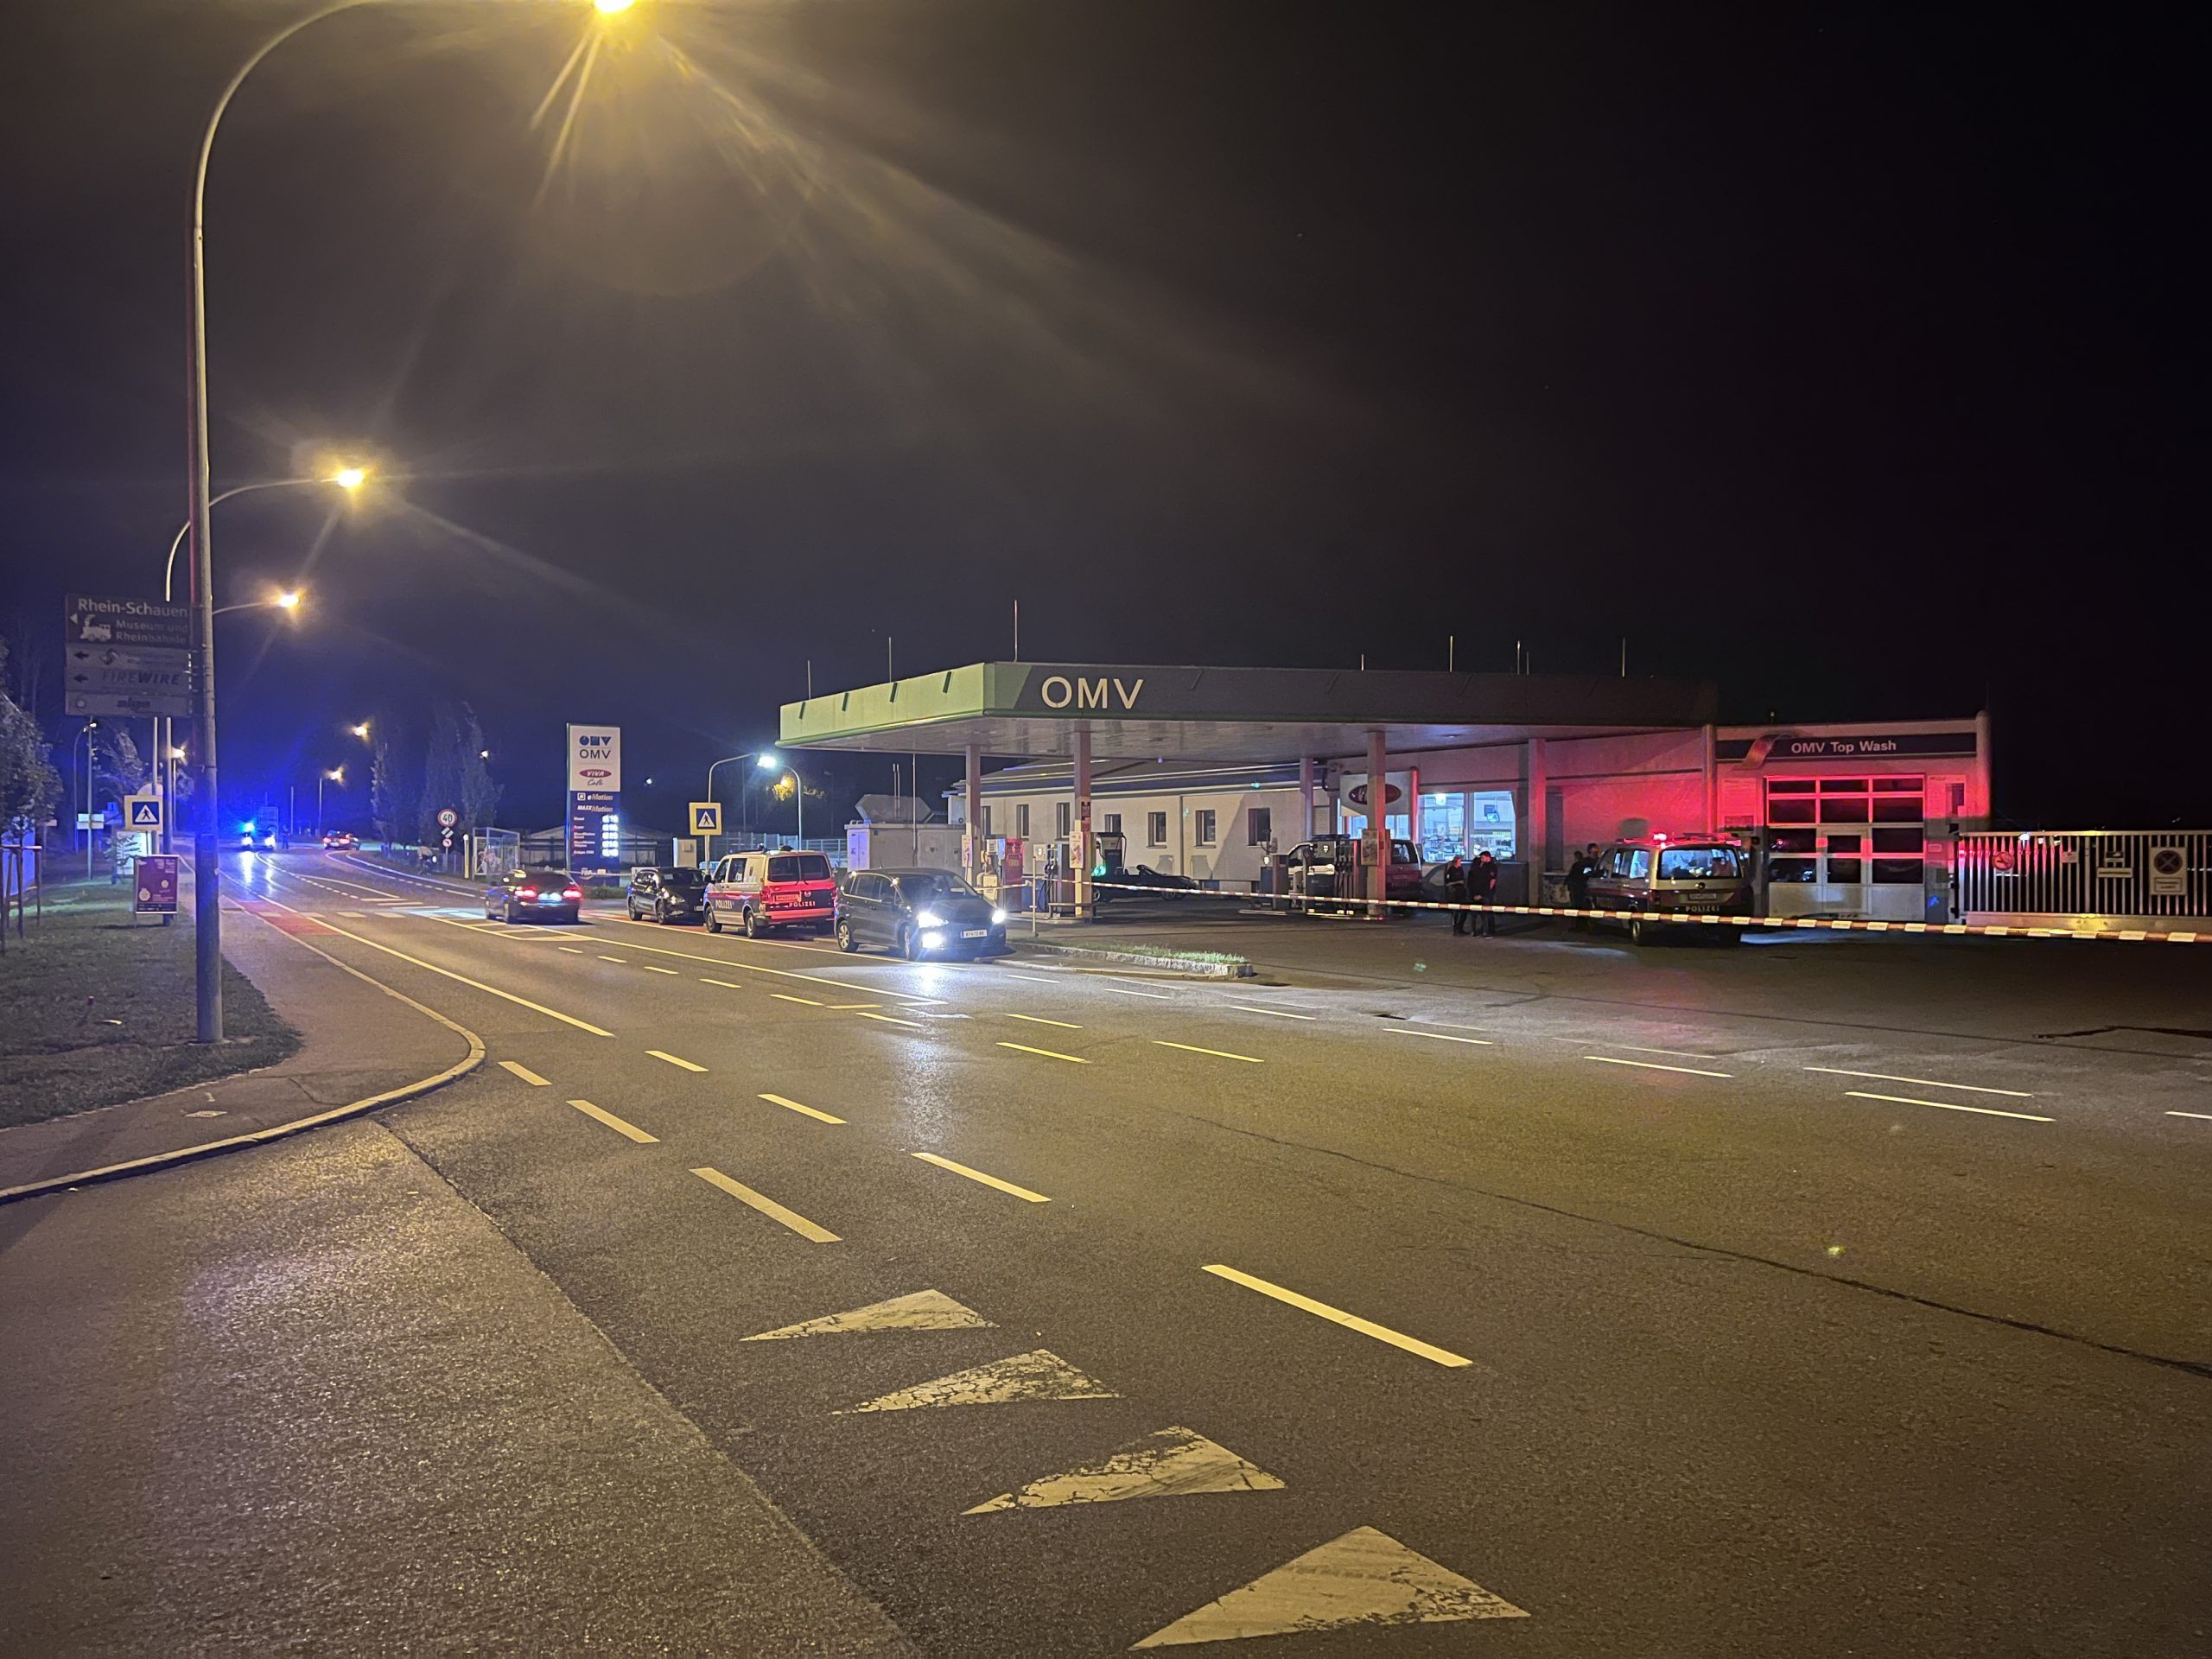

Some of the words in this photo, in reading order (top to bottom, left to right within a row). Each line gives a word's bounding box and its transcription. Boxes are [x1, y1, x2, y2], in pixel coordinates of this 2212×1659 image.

[78, 598, 188, 618] Rhein-Schauen
[116, 620, 164, 631] Museum
[167, 622, 188, 632] und
[102, 671, 181, 685] FIREWIRE
[1041, 676, 1144, 709] OMV
[579, 748, 611, 759] OMV
[1791, 742, 1826, 753] OMV
[1830, 741, 1854, 754] Top
[1859, 741, 1897, 752] Wash
[442, 814, 453, 823] 40
[715, 899, 733, 909] POLIZEI
